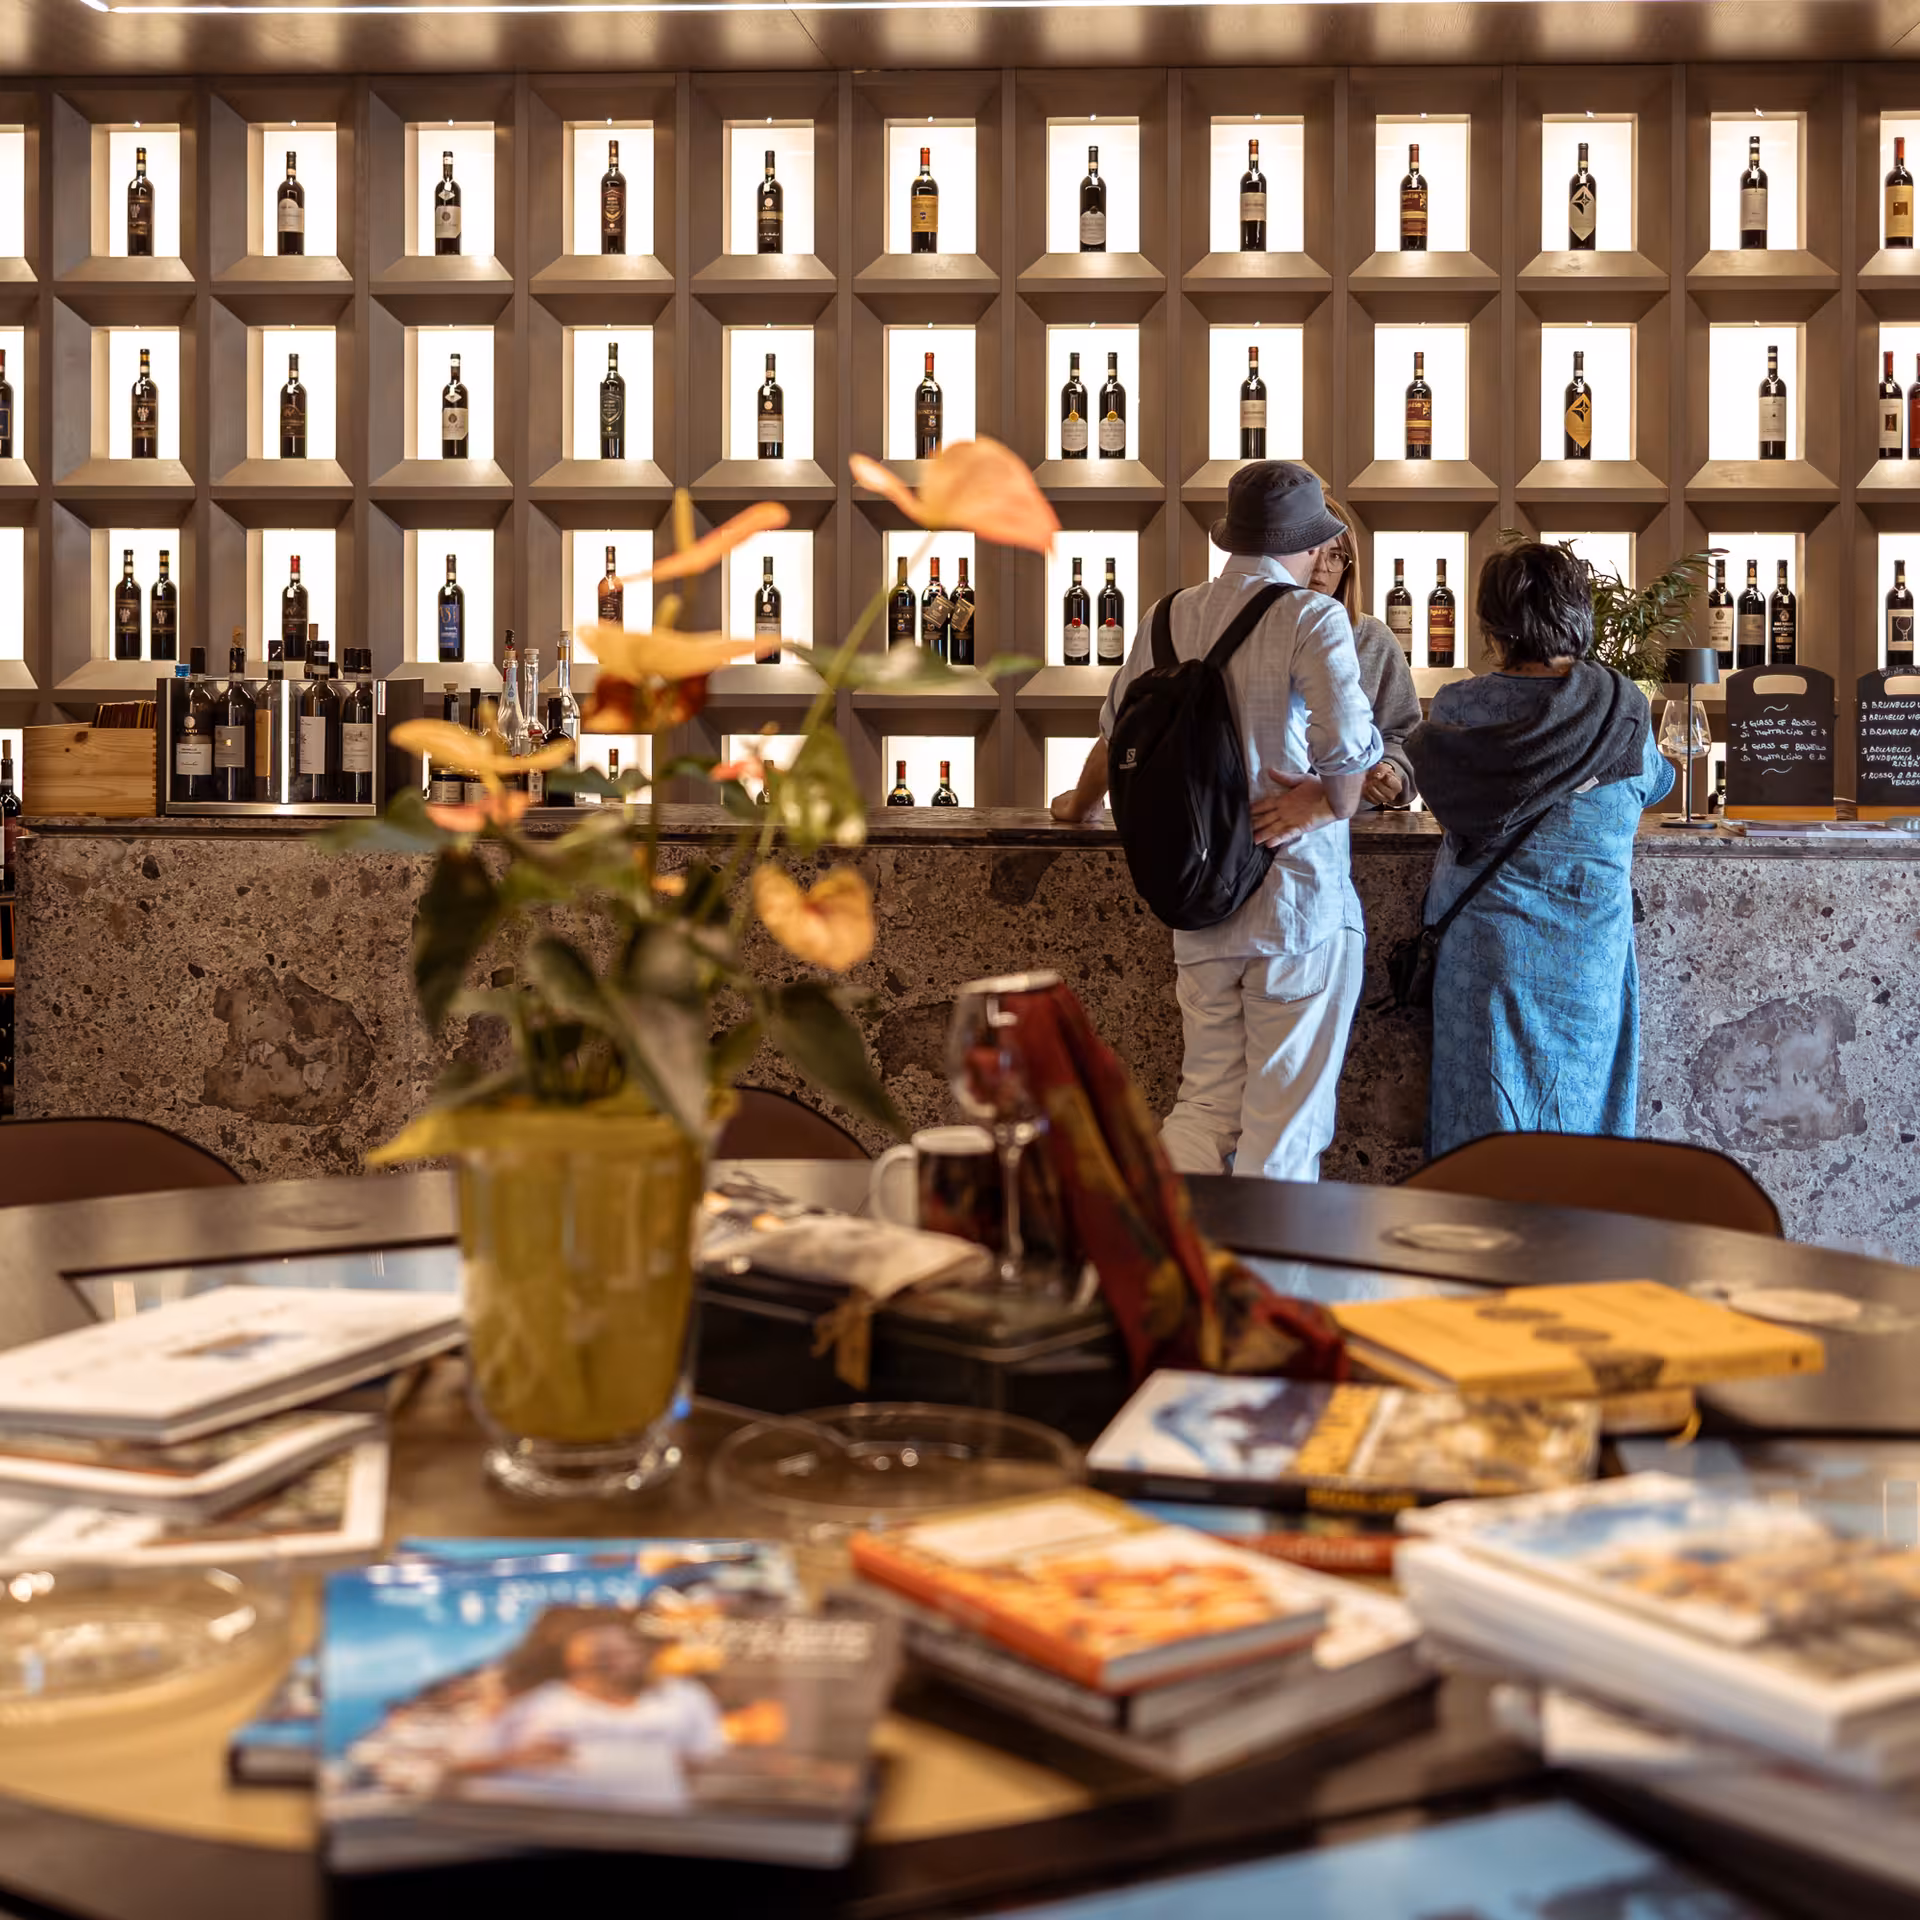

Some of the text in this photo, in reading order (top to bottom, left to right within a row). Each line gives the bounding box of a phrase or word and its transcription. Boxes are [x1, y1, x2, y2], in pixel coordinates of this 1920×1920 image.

[1871, 701, 1916, 709] BRUNELLO
[1860, 714, 1867, 722] 3
[1749, 719, 1774, 728] GLASS
[1791, 718, 1817, 726] ROSSO
[1861, 728, 1867, 736] 3
[1869, 728, 1908, 736] BRUNELLO
[1861, 747, 1868, 755] 3
